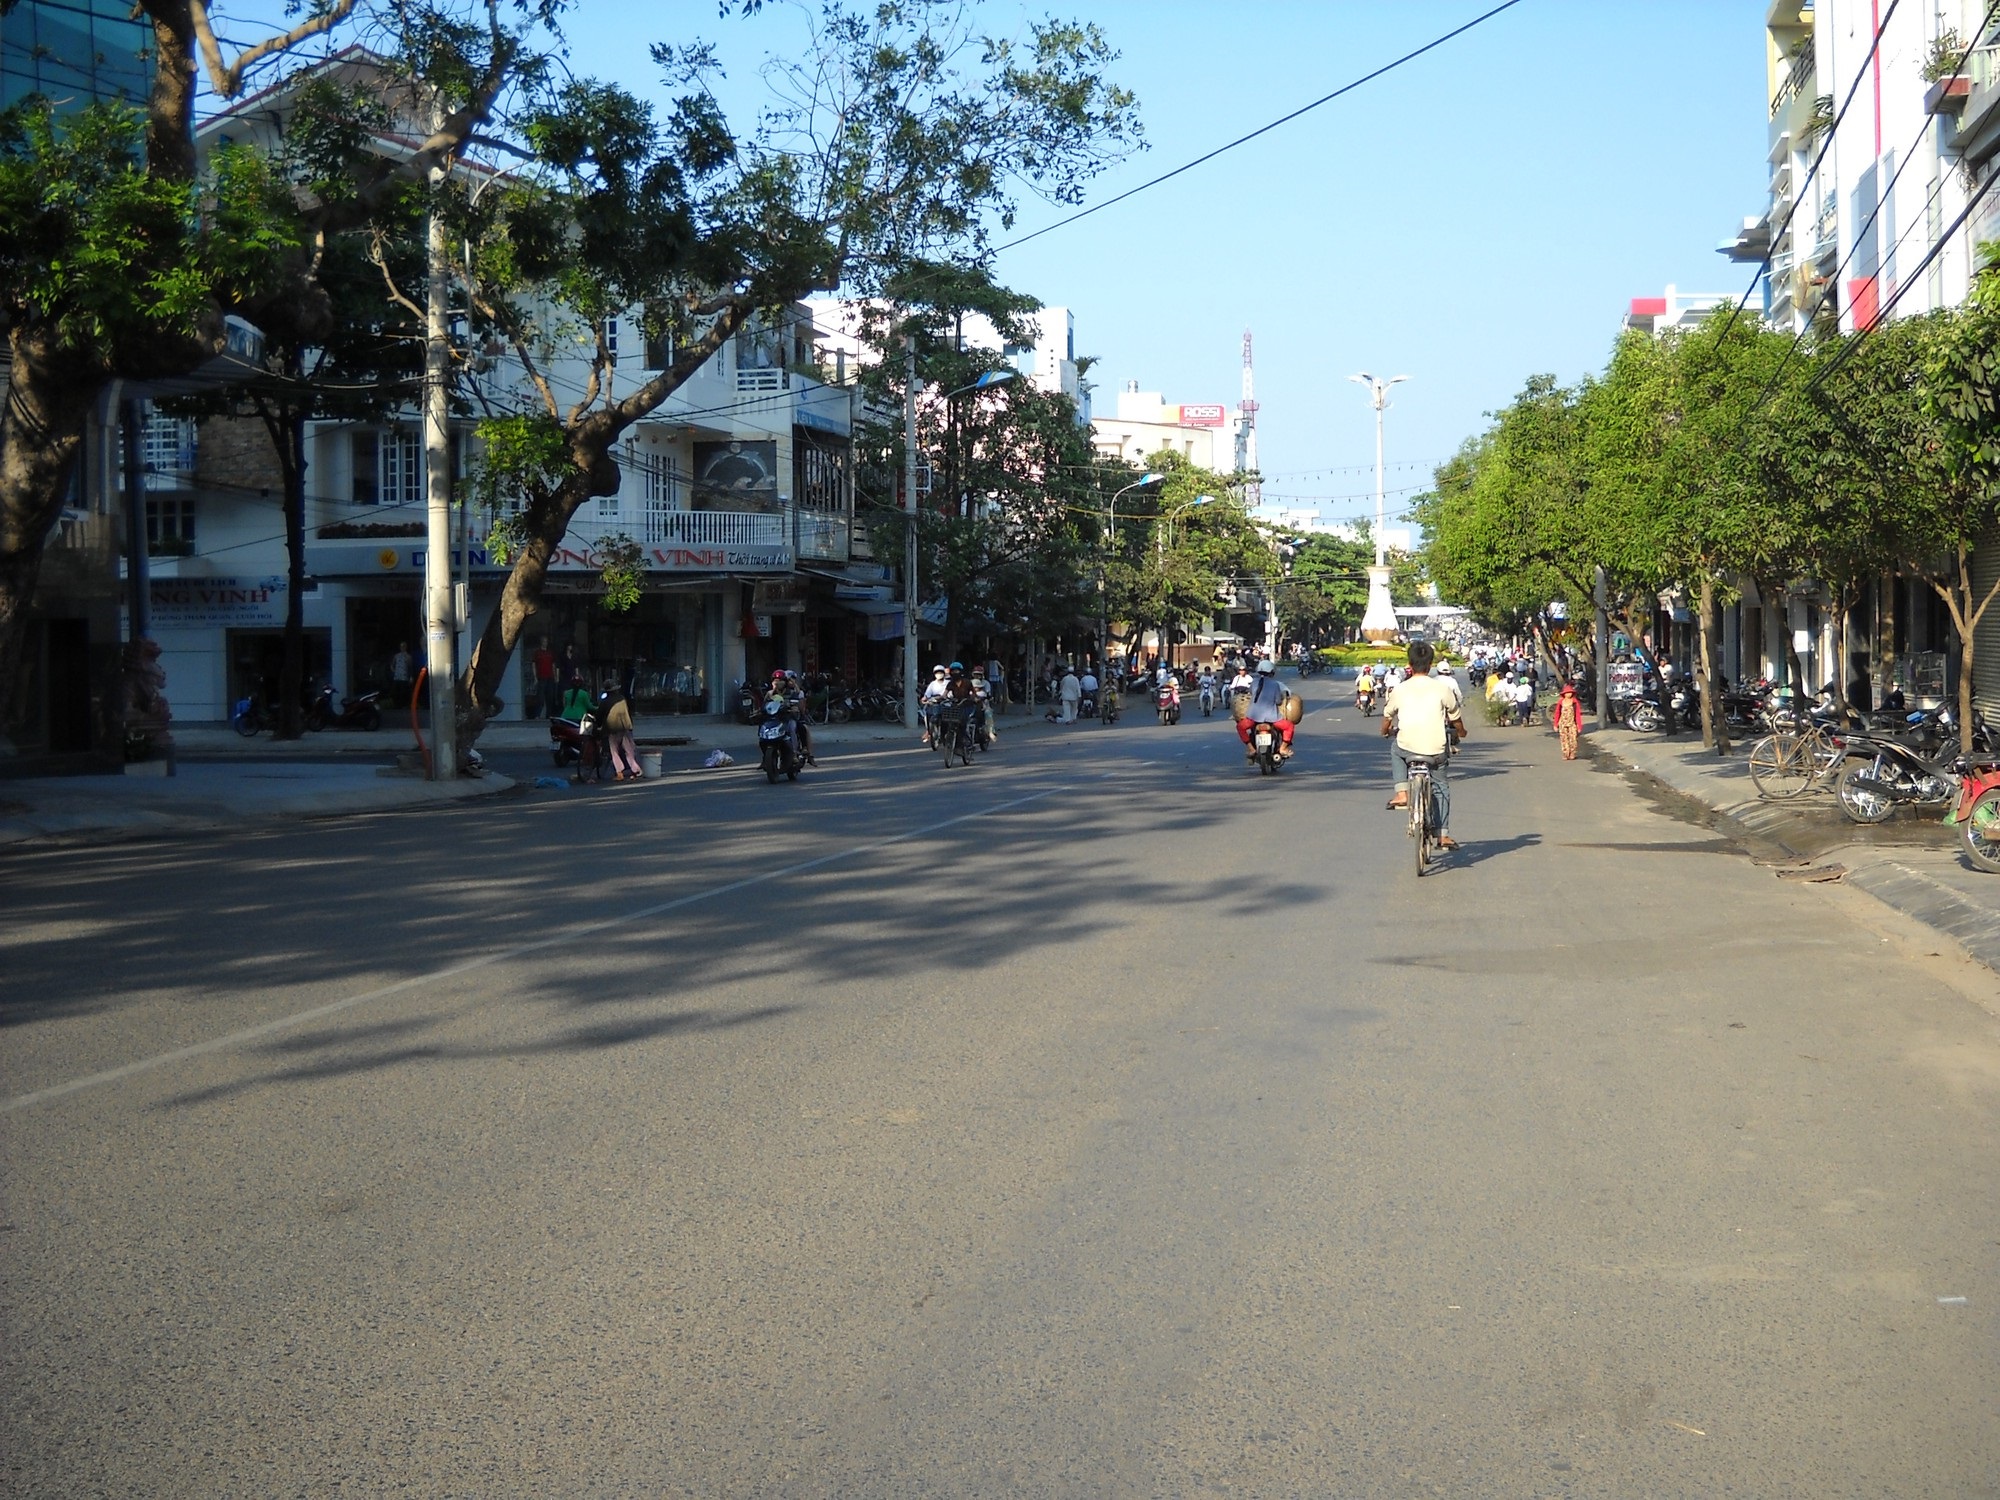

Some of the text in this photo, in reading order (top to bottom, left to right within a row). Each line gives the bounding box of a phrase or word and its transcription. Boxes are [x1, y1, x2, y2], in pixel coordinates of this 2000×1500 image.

[1184, 407, 1220, 418] ROSSI
[412, 550, 487, 565] DTN
[653, 549, 725, 566] VINH
[199, 588, 270, 604] VINH
